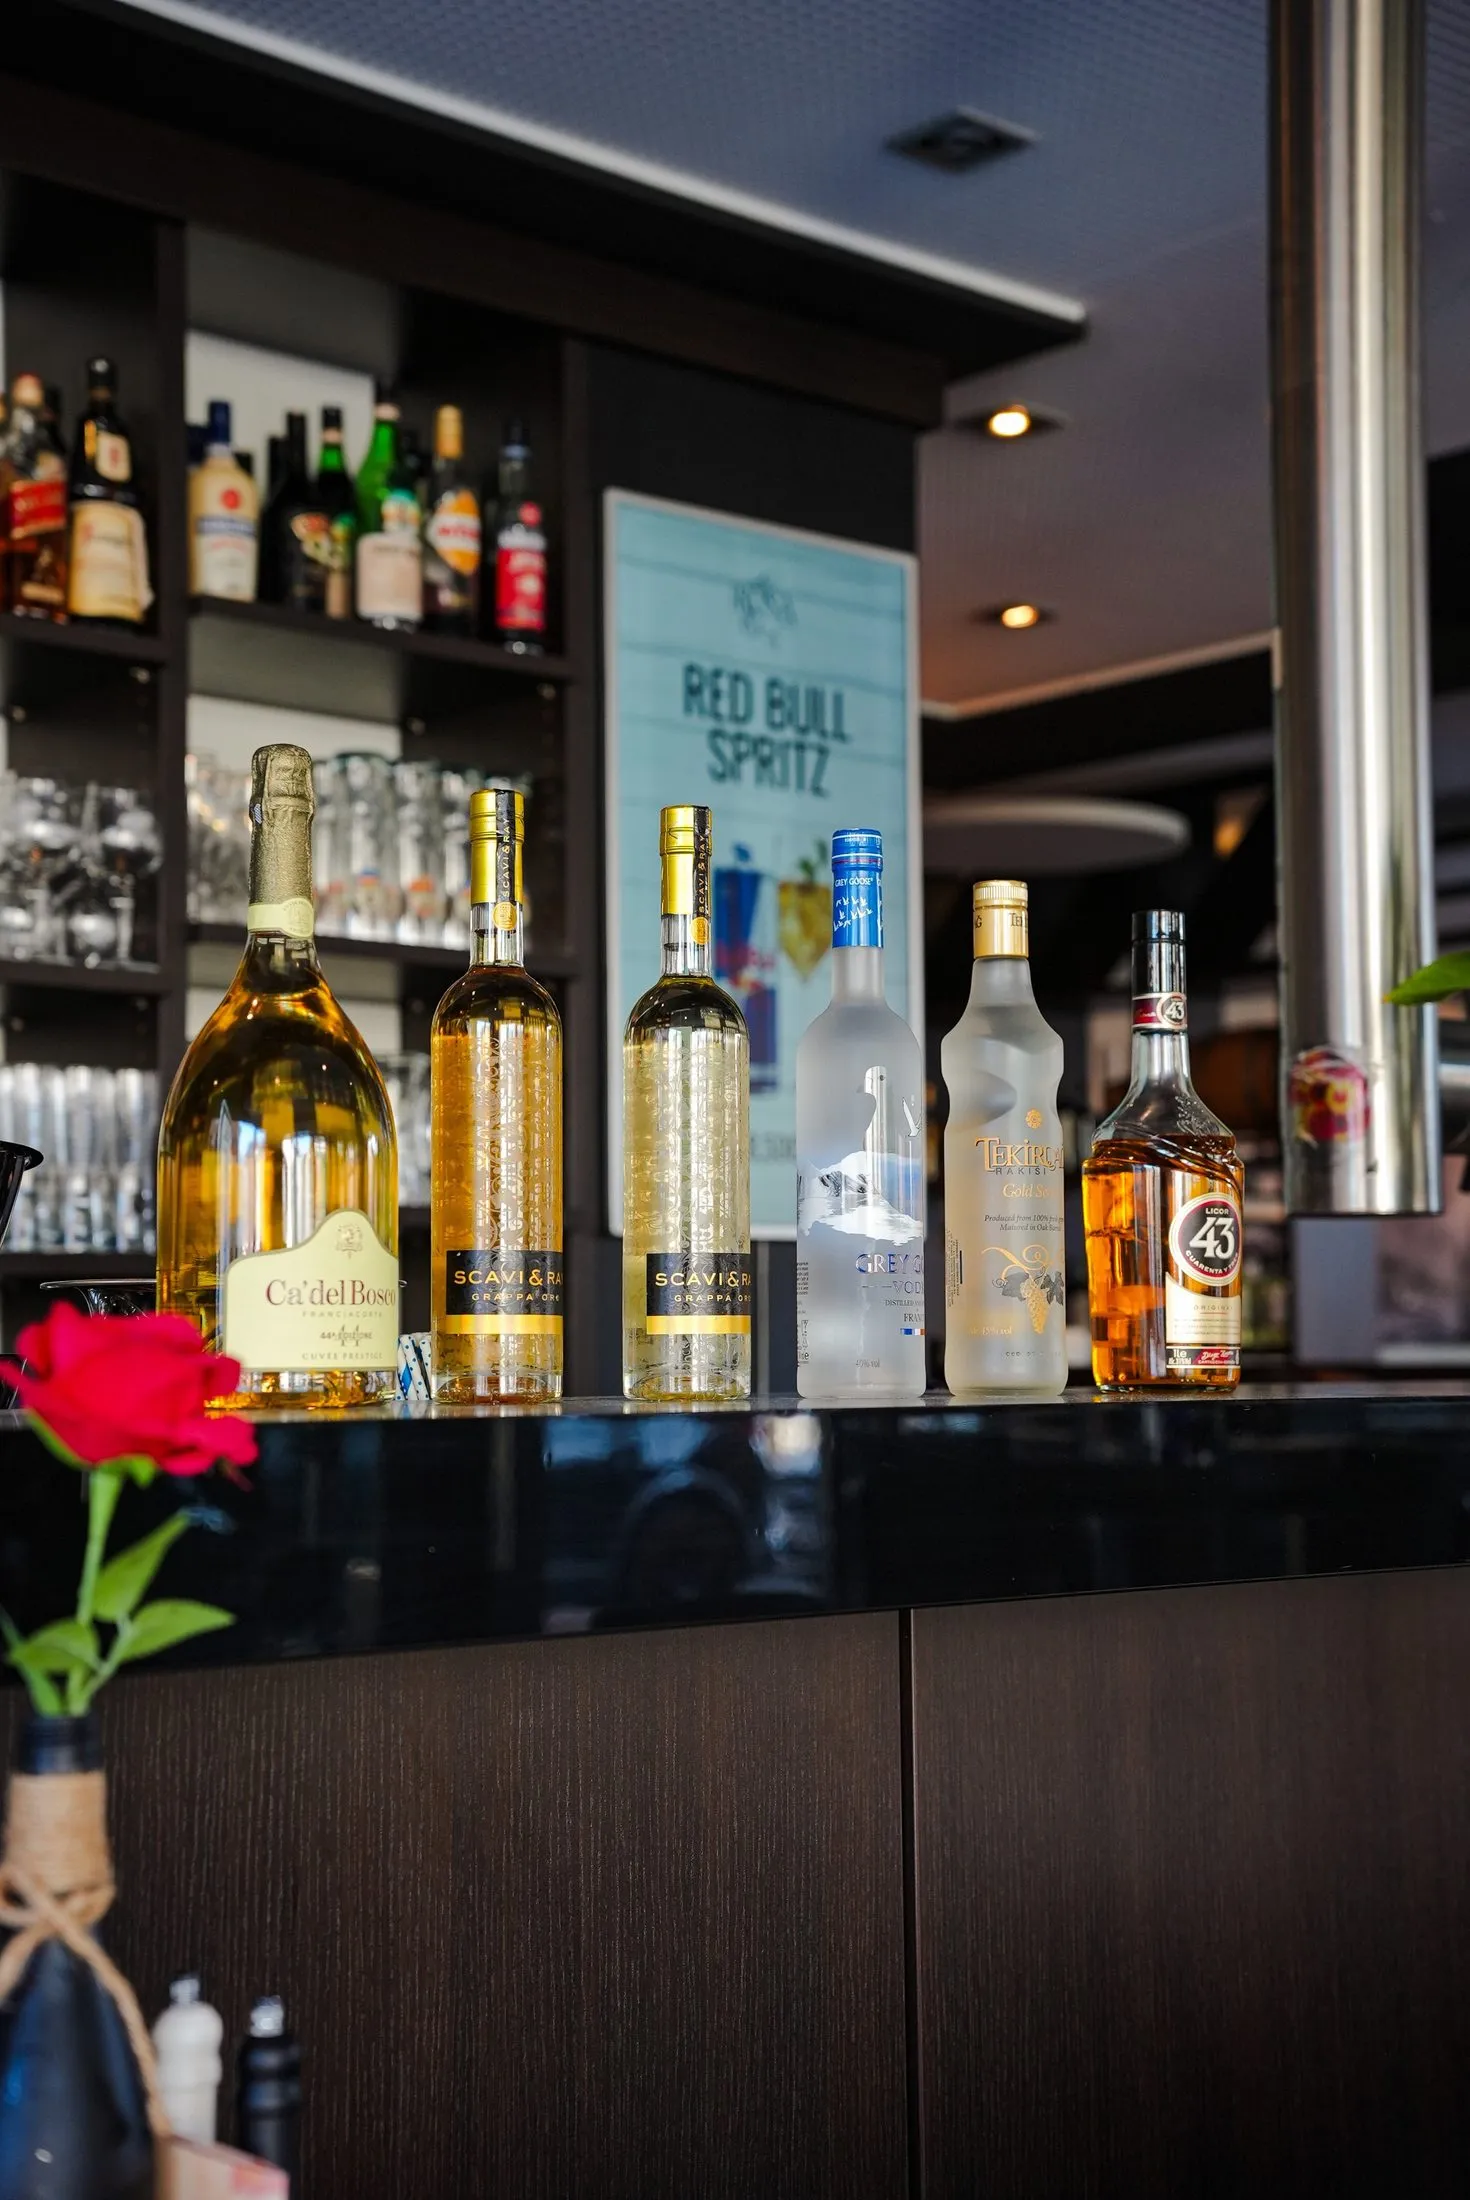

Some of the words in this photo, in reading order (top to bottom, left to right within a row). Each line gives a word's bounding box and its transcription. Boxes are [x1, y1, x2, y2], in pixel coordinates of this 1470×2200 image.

[682, 662, 754, 725] RED
[764, 676, 850, 744] BULL
[706, 727, 831, 797] SPRITZ
[502, 817, 511, 843] RAY
[502, 854, 511, 898] SCAVI
[1166, 1001, 1184, 1019] 43
[1002, 1183, 1033, 1198] Gold
[984, 1214, 1015, 1222] Produced
[1016, 1214, 1032, 1223] from
[1033, 1214, 1049, 1222] 100%
[1205, 1207, 1229, 1215] LICOR
[1189, 1216, 1235, 1260] 43
[855, 1253, 909, 1274] GREY
[1185, 1250, 1223, 1274] CUARENTA
[454, 1270, 523, 1285] SCAVI
[528, 1269, 543, 1286] &
[655, 1272, 723, 1287] SCAVI
[727, 1271, 739, 1287] &
[350, 1279, 396, 1307] Bosco
[892, 1280, 923, 1294] VOD
[471, 1293, 534, 1302] GRAPPA
[674, 1294, 732, 1302] GRAPPA
